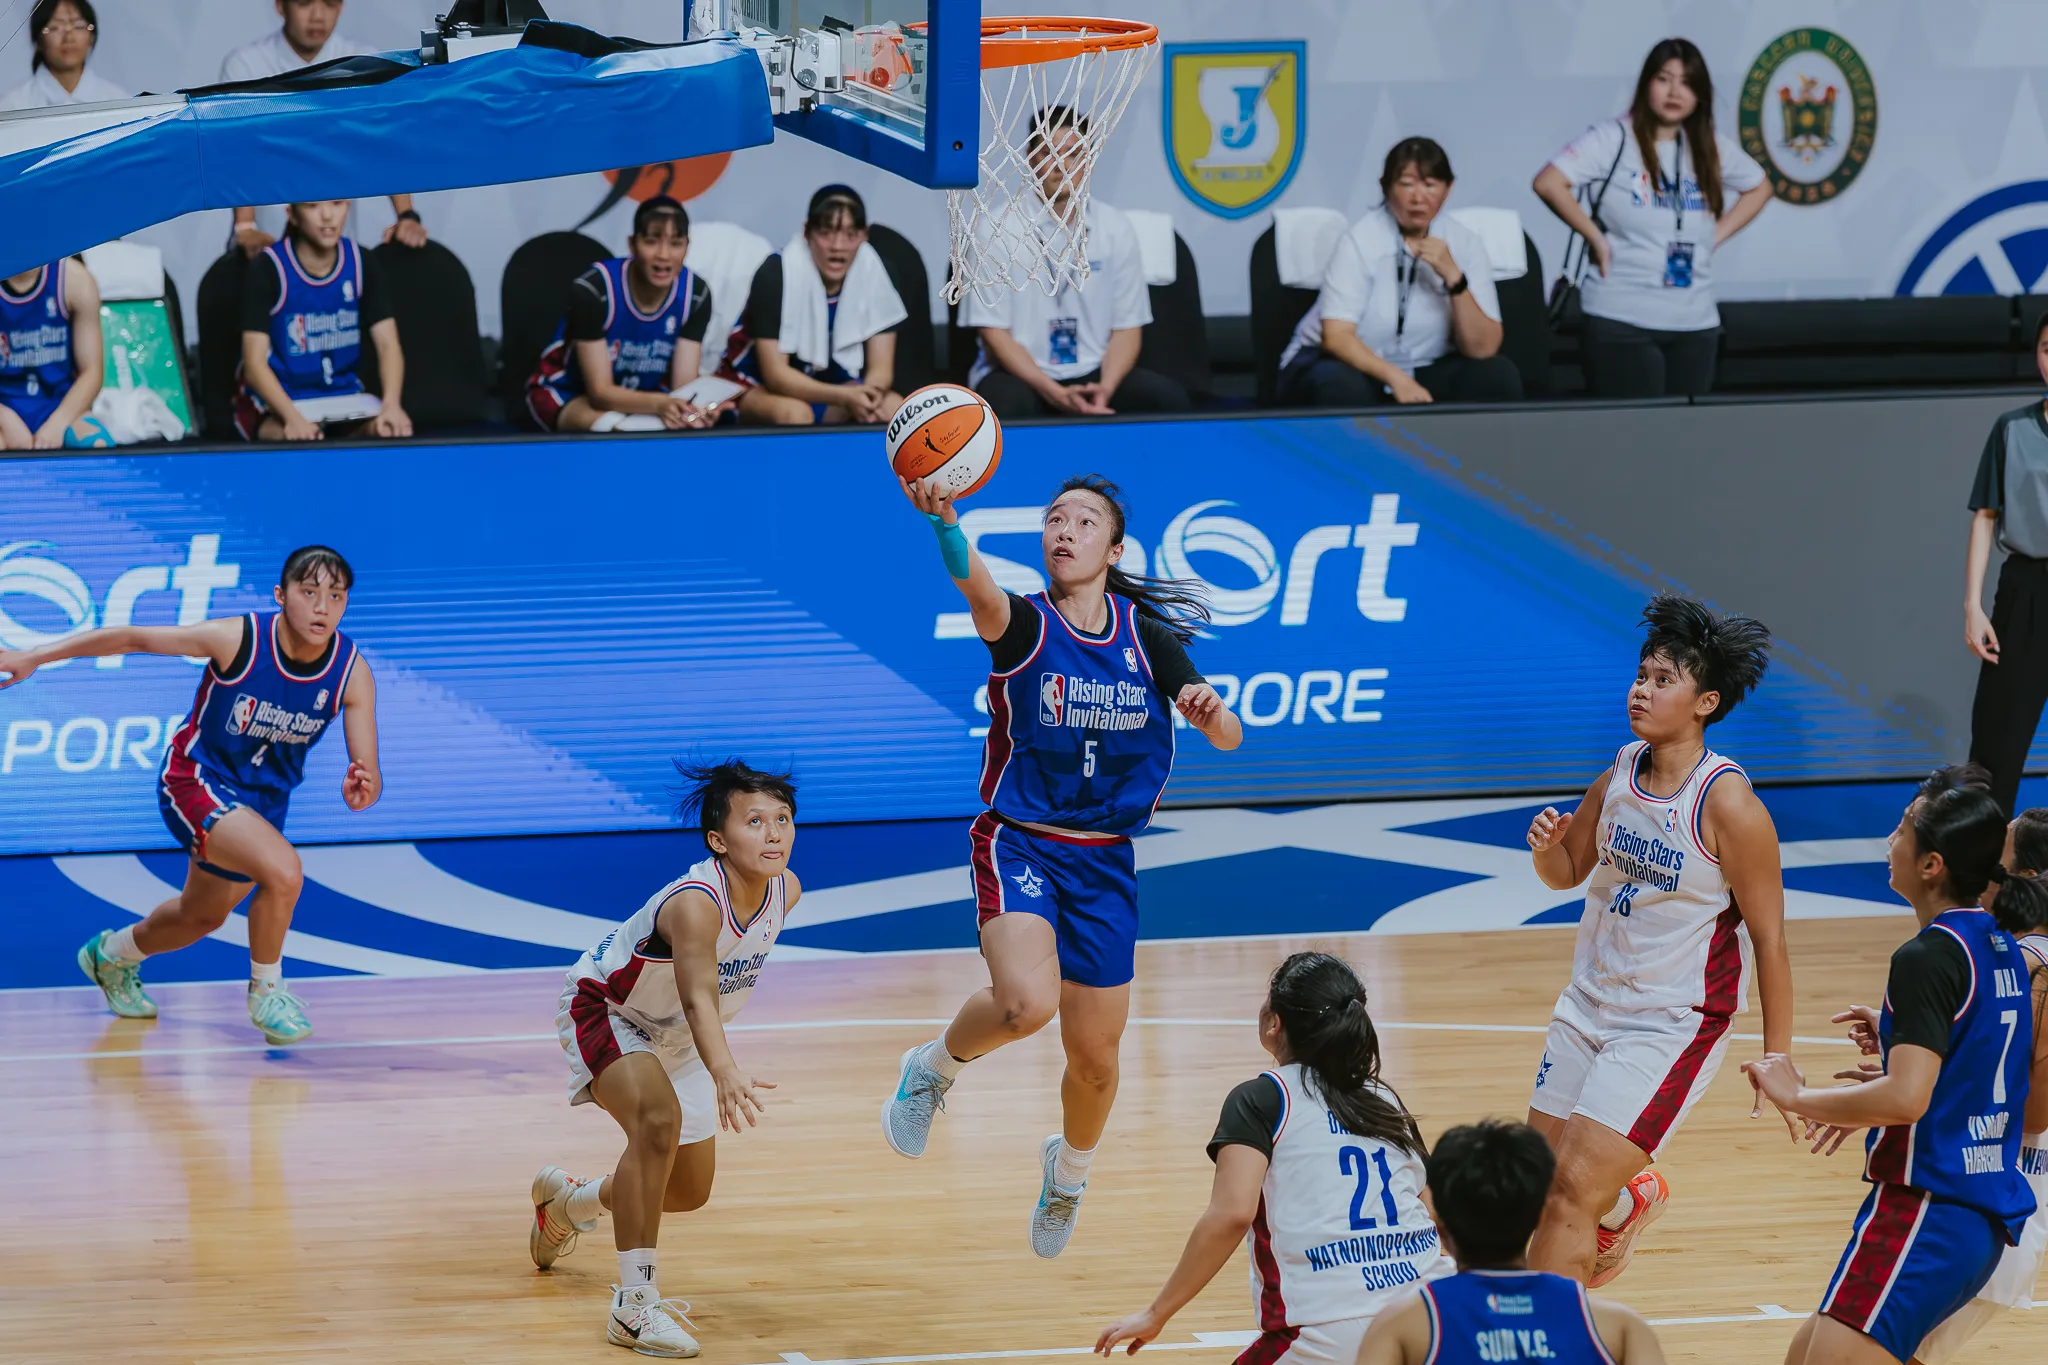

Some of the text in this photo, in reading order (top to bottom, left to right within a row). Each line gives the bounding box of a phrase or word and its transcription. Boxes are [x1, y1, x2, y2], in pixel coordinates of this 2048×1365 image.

[888, 394, 951, 443] Wilson
[1068, 676, 1147, 709] Rising Stars
[255, 700, 325, 733] Rising Stars
[1065, 703, 1149, 731] Invitational
[1083, 740, 1098, 778] 5
[1612, 824, 1684, 871] Rising Stars
[1610, 849, 1680, 892] Invitational
[1993, 1010, 2017, 1104] 7
[1339, 1145, 1399, 1231] 21
[1361, 1260, 1420, 1292] SCHOOL
[1476, 1328, 1556, 1363] SUN Y.C.
